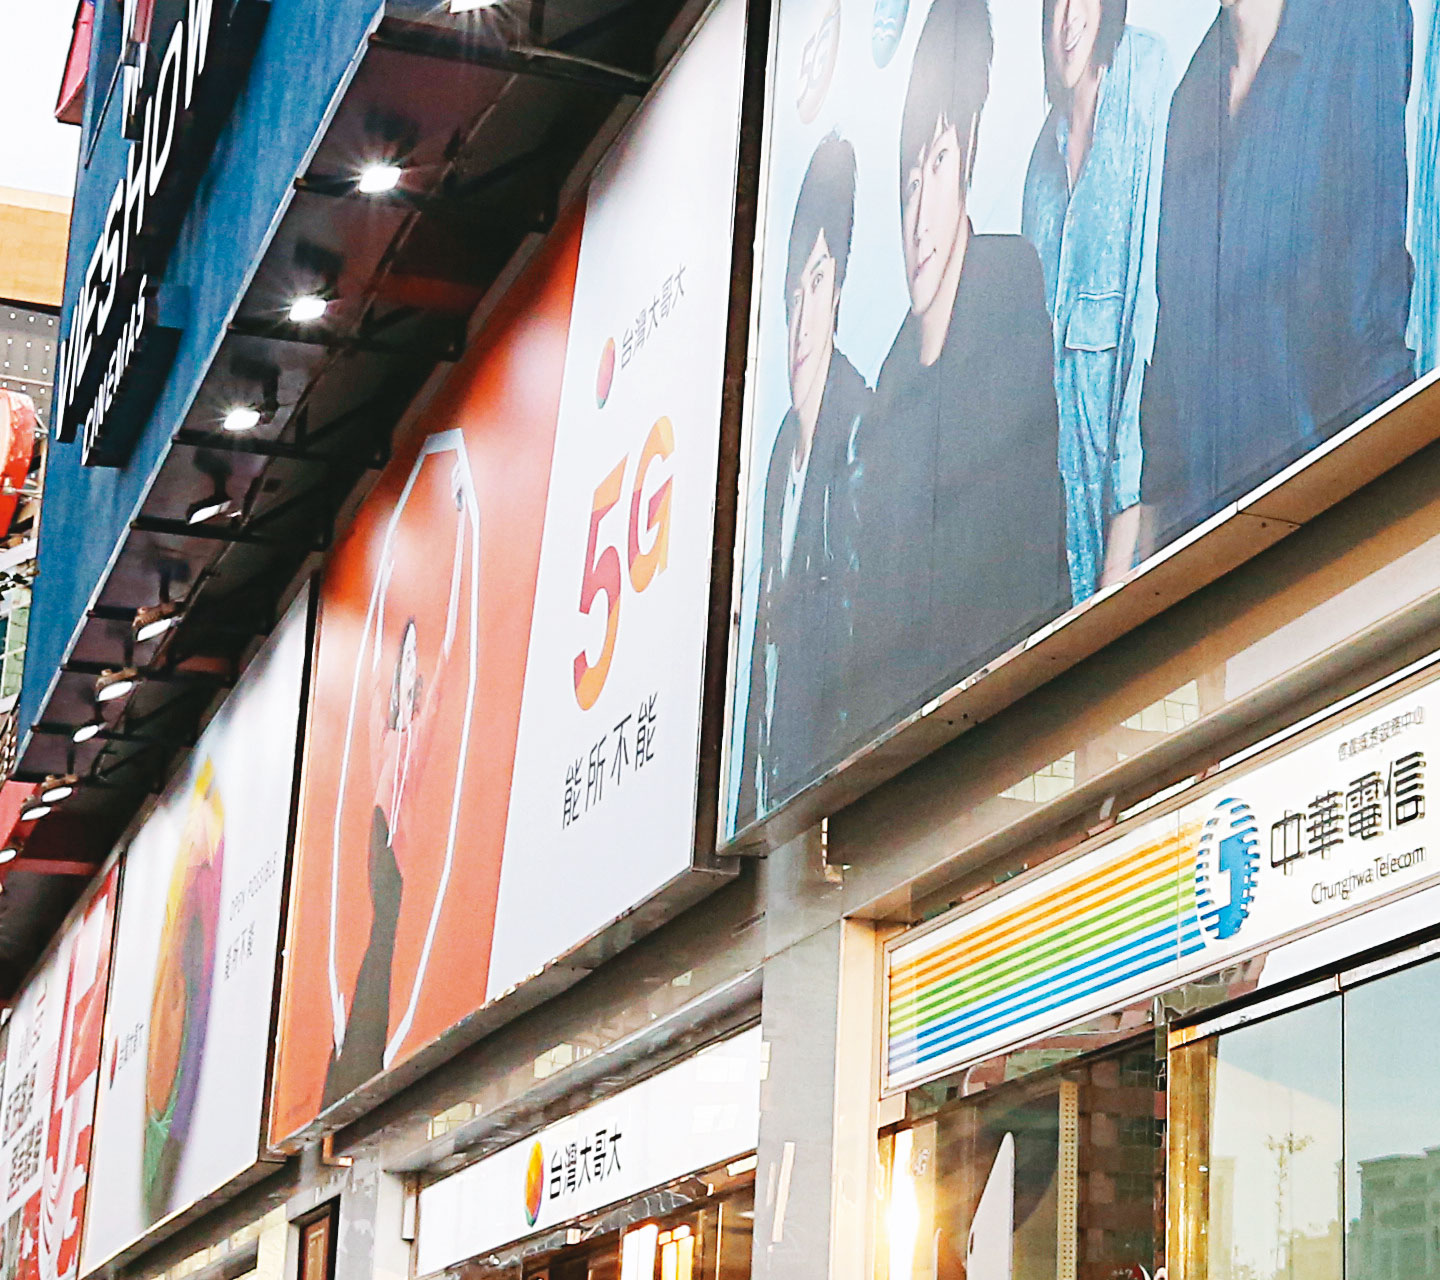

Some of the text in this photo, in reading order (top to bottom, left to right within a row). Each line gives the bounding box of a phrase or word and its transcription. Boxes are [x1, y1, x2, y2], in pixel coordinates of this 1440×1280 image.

[620, 263, 688, 372] 台灣大哥大
[572, 414, 677, 712] 5G
[560, 690, 660, 832] 能所不能
[1269, 749, 1427, 877] 中華電信
[1310, 843, 1427, 906] Chunghwa Telecom
[548, 1121, 623, 1201] 台灣大哥大
